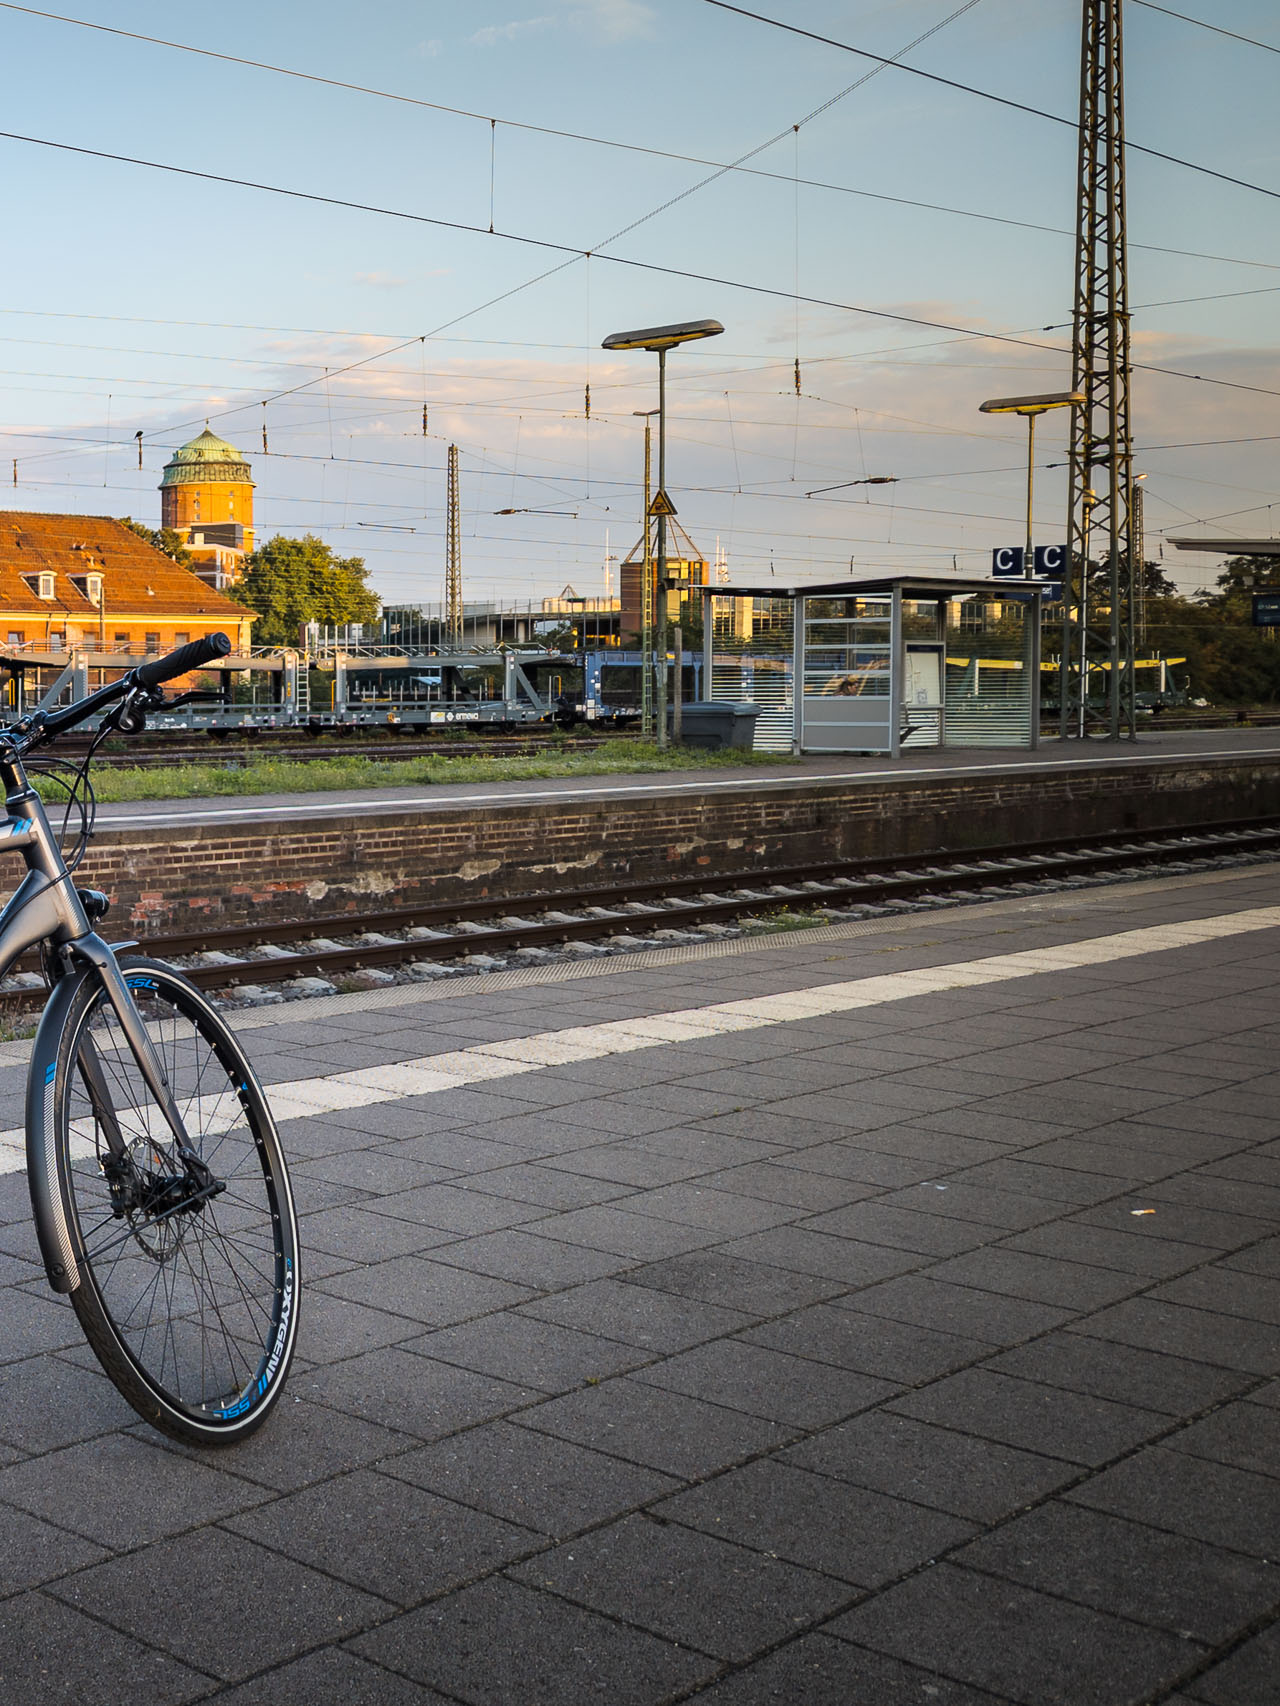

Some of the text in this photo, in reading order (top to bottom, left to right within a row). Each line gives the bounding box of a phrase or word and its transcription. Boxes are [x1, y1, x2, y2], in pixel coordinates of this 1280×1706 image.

[996, 548, 1014, 570] C
[1043, 545, 1062, 568] C
[269, 1270, 293, 1374] OXYGEN
[213, 1396, 251, 1420] SSL
